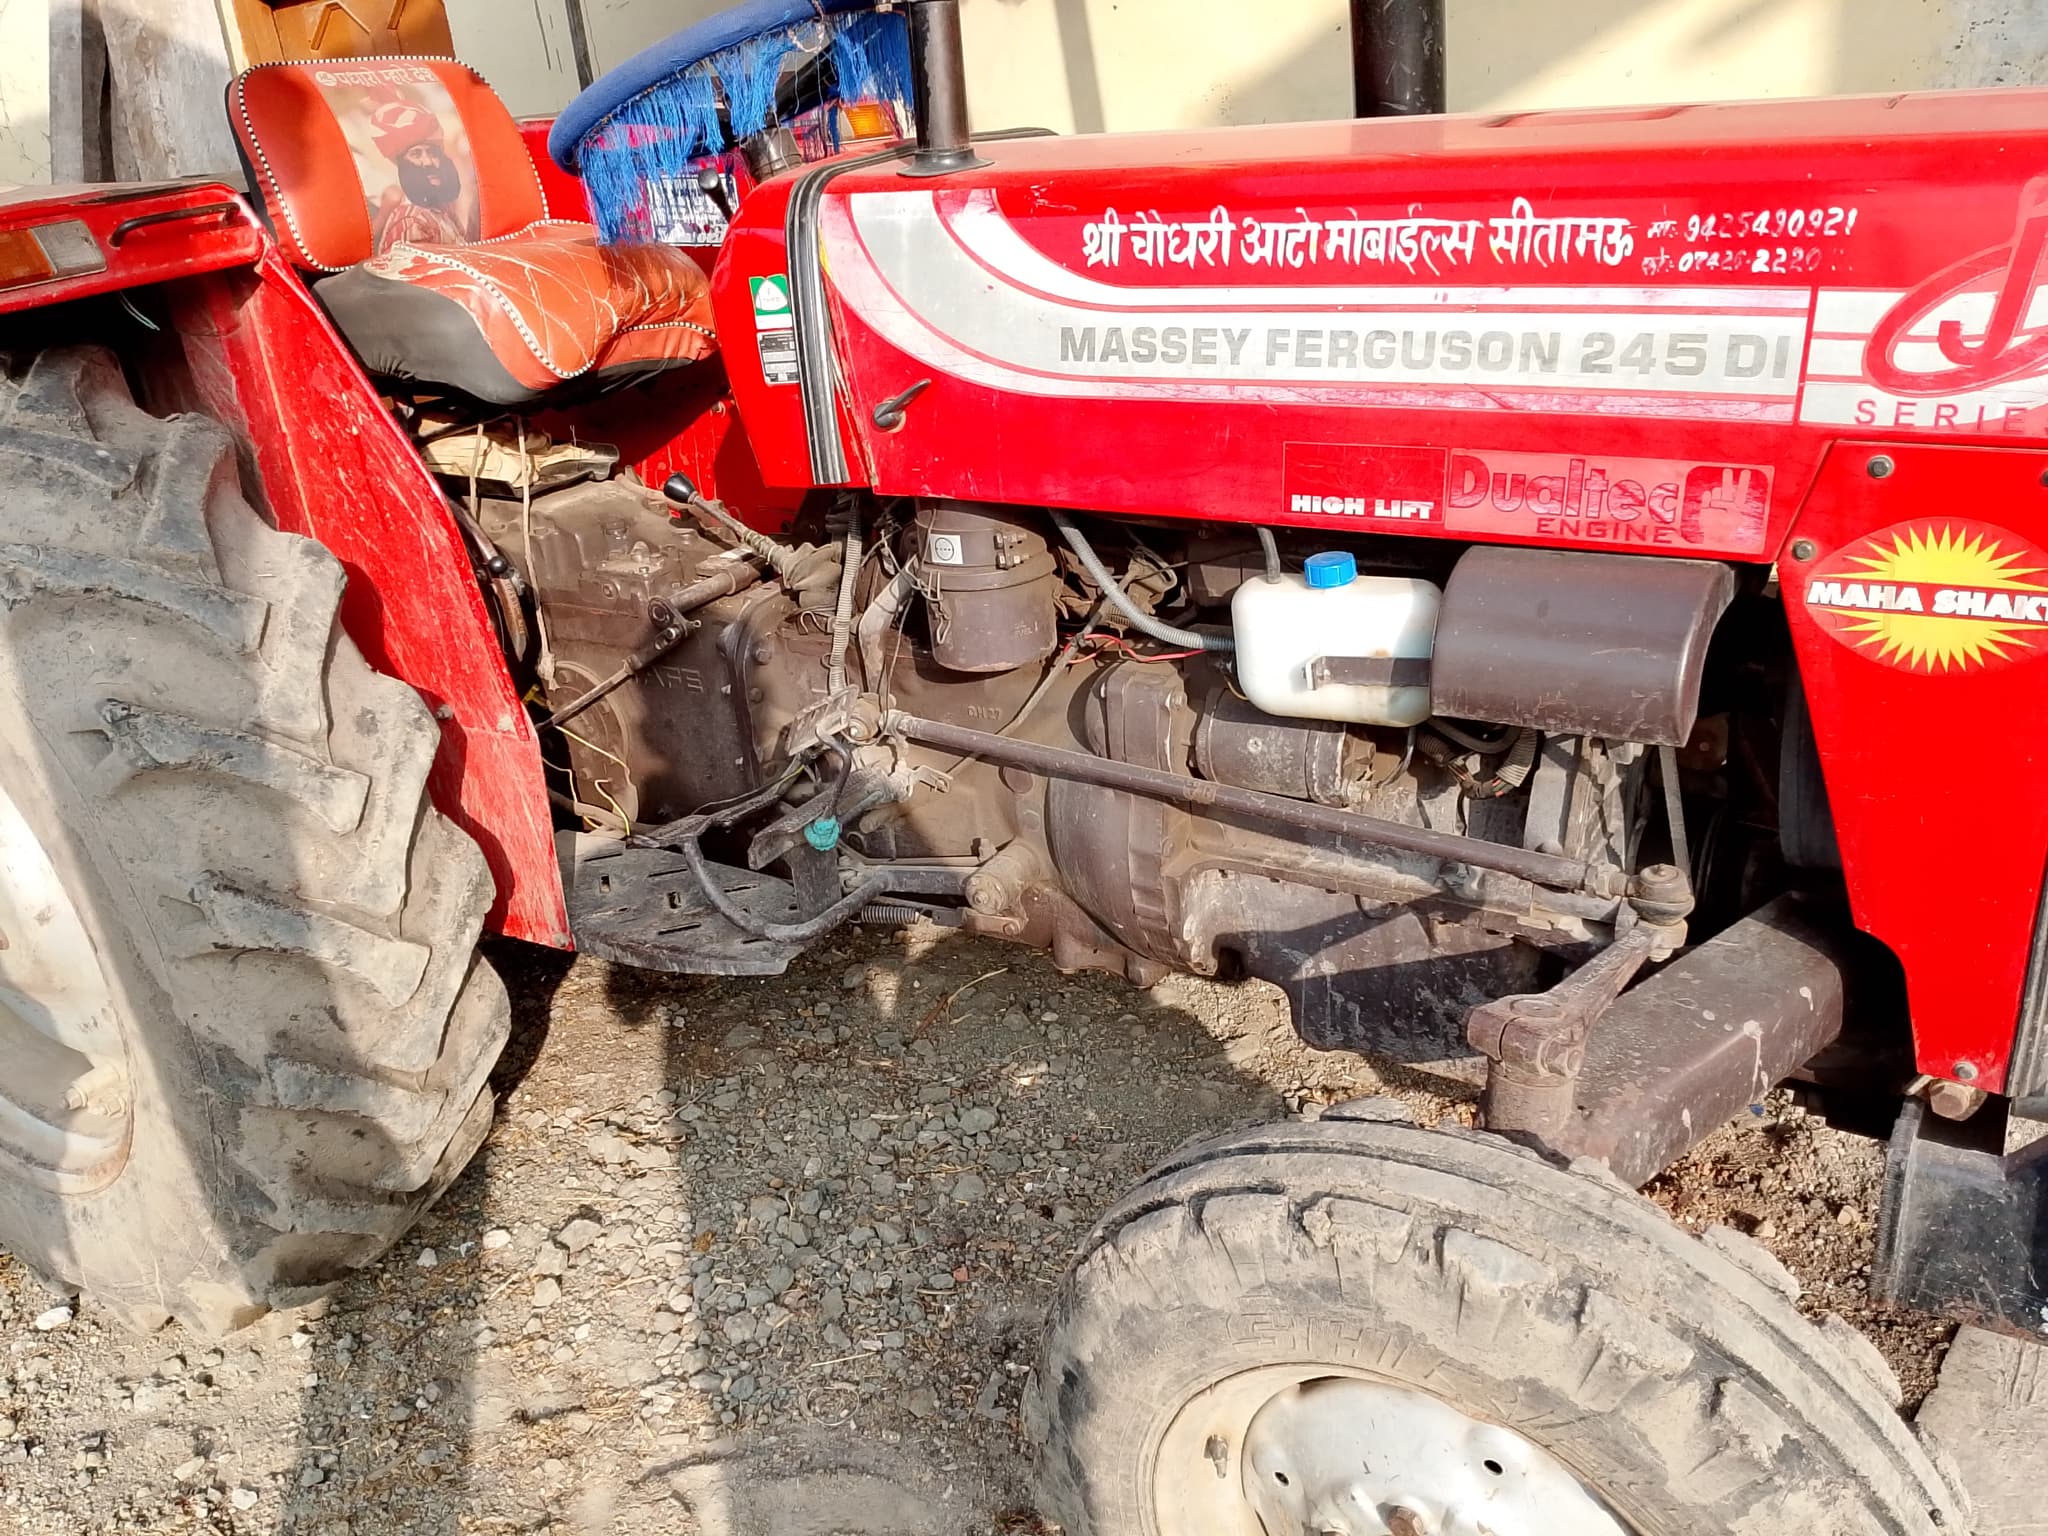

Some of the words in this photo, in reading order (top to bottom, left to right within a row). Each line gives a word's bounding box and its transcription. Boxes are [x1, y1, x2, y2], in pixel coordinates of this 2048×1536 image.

[1082, 207, 1128, 268] श्री
[1240, 207, 1323, 269] आटो
[1489, 196, 1636, 267] सीतामऊ
[1060, 326, 1252, 366] MASSEY
[1265, 328, 1561, 374] FERGUSON
[1580, 332, 1708, 376] 245
[1724, 334, 1791, 379] DI
[1854, 399, 2048, 435] SERIE
[1291, 494, 1365, 516] HIGH
[1374, 499, 1434, 520] LIFT
[1447, 454, 1680, 524] Dualtec
[1536, 517, 1680, 545] ENGINE
[1806, 580, 1925, 613] MAHA
